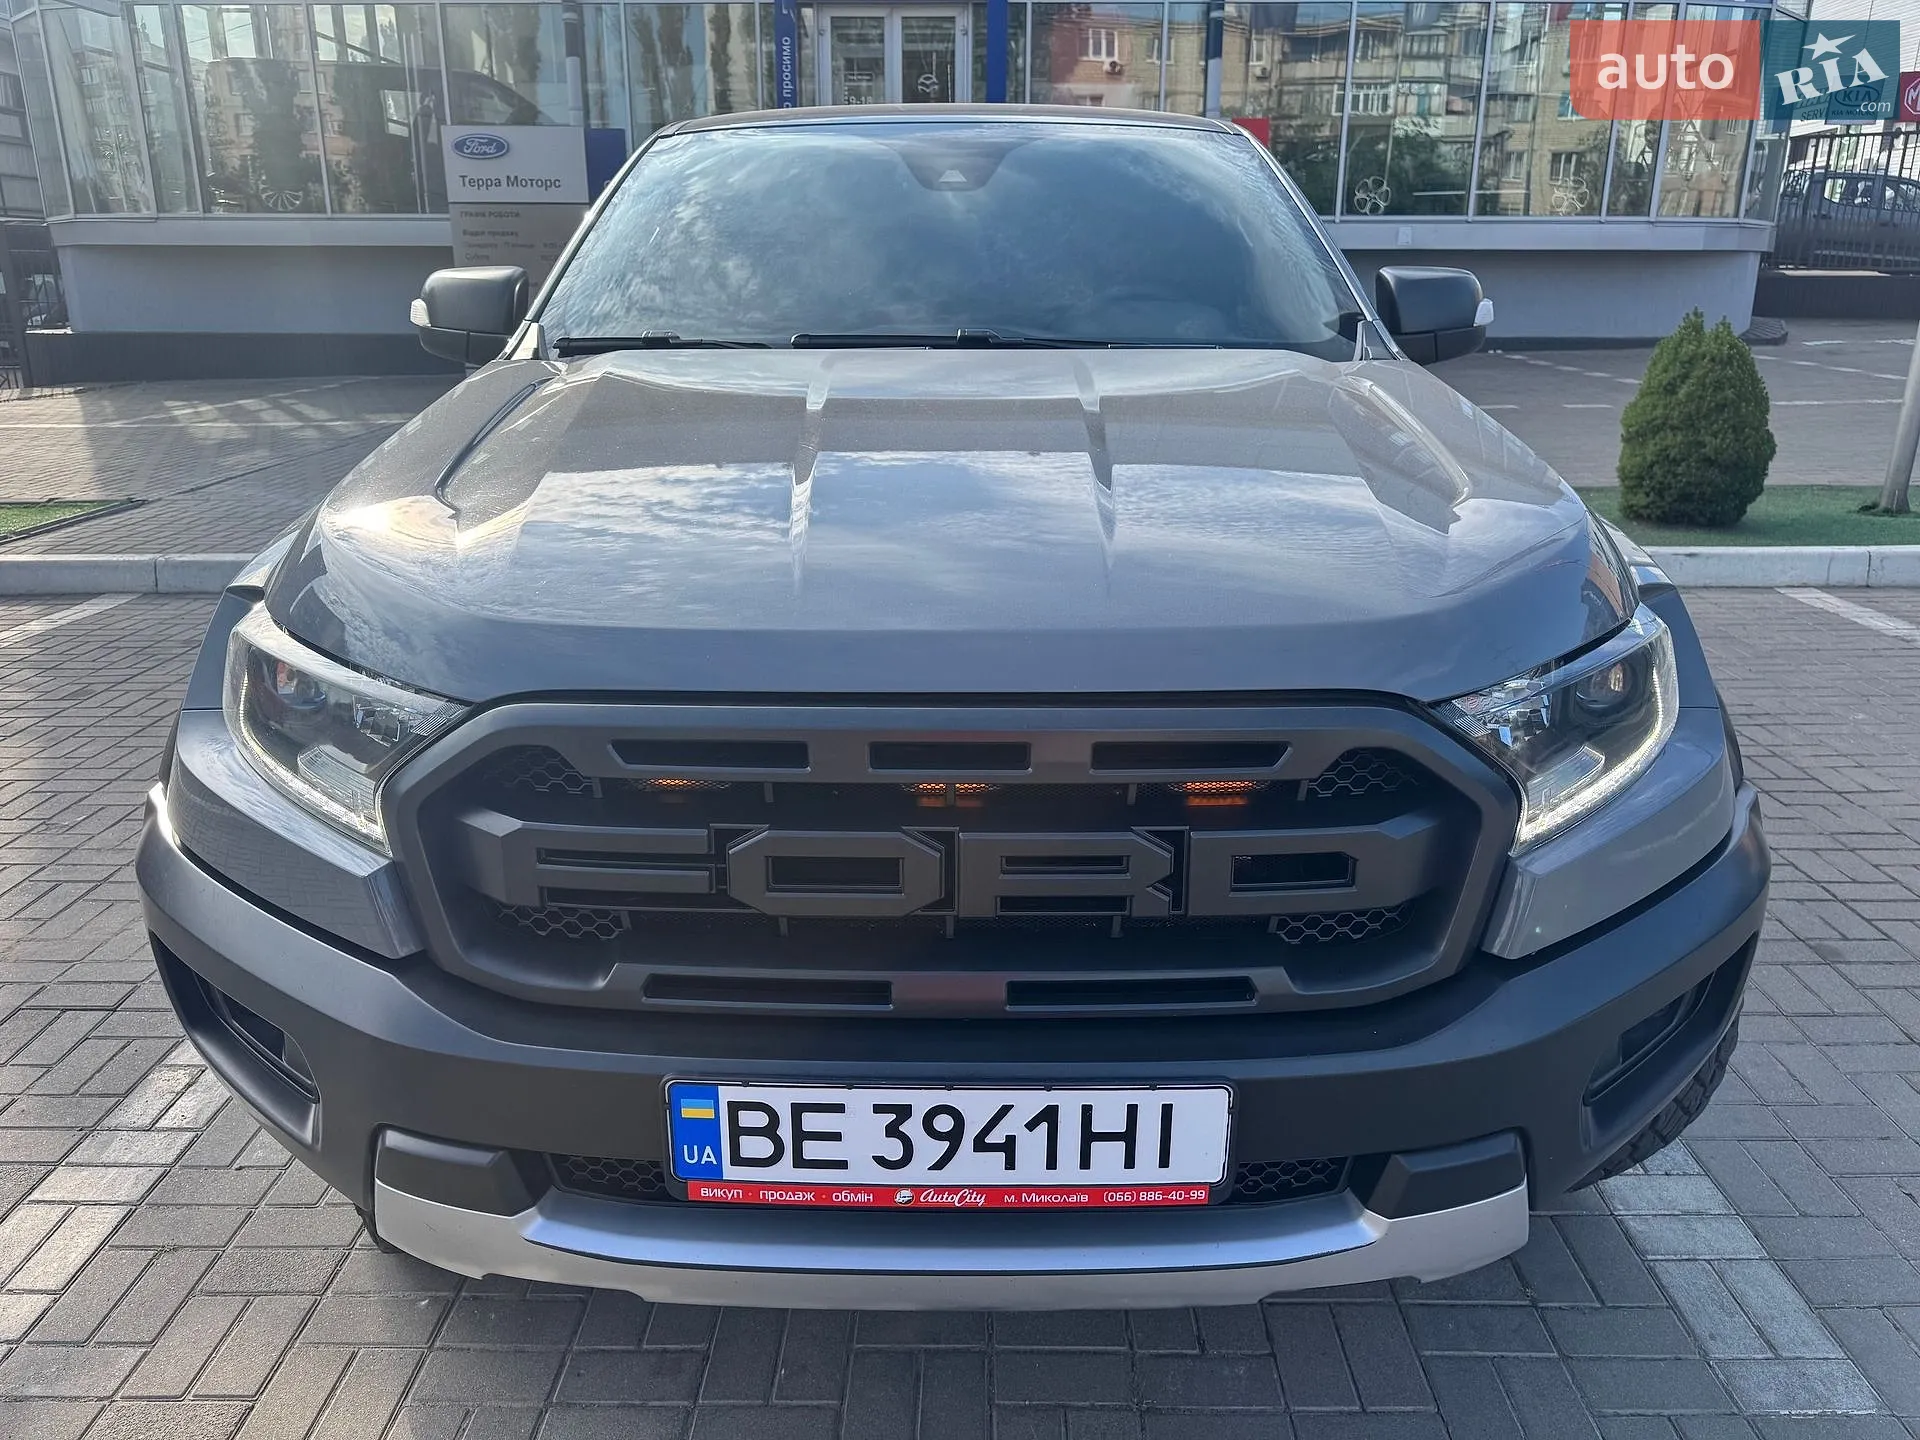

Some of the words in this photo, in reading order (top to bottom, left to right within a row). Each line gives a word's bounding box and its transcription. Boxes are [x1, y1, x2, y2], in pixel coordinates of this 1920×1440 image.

[782, 37, 793, 97] просимо
[463, 138, 498, 154] Ford
[459, 174, 501, 190] Терра
[506, 175, 562, 191] Моторс
[462, 808, 1437, 918] FORD
[727, 1101, 849, 1170] BE
[683, 1145, 717, 1165] UA
[700, 1187, 743, 1199] викуп
[759, 1190, 815, 1202] продаж
[832, 1190, 873, 1203] обмін
[919, 1188, 987, 1207] AutoCity
[1004, 1194, 1018, 1203] м.
[1022, 1192, 1089, 1203] Миколаїв
[1103, 1191, 1137, 1203] (066)
[1139, 1190, 1206, 1201] 886-40-99
